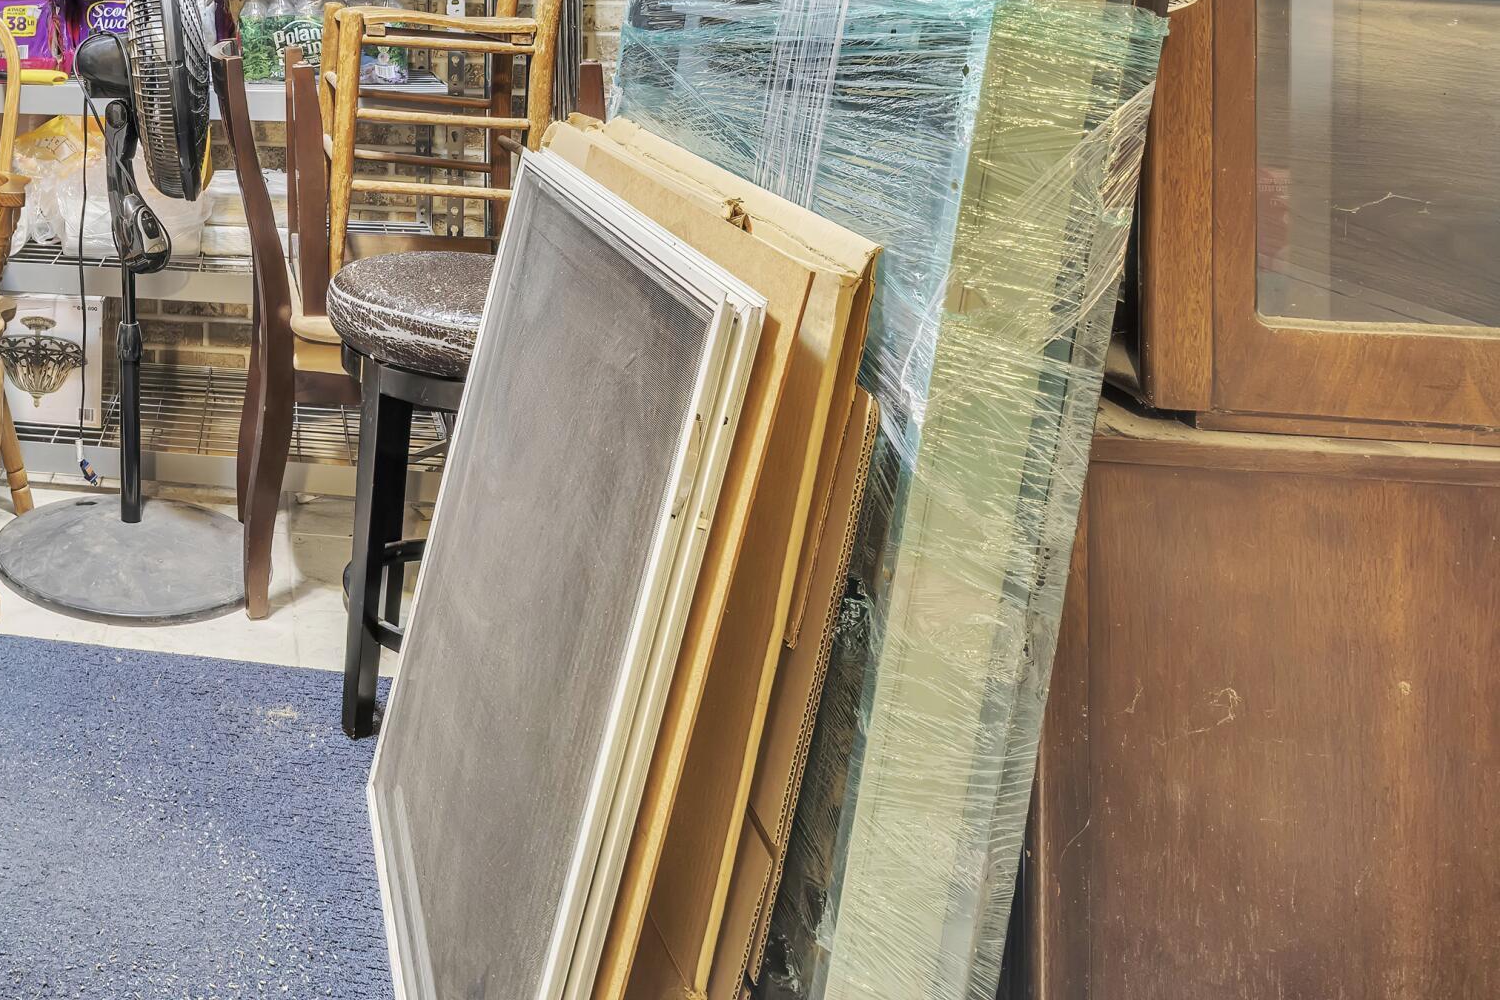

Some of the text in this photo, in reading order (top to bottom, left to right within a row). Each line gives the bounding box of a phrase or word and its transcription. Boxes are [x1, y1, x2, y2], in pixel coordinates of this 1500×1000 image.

[6, 15, 27, 31] 38
[93, 17, 129, 31] Awa
[273, 27, 323, 50] Polan
